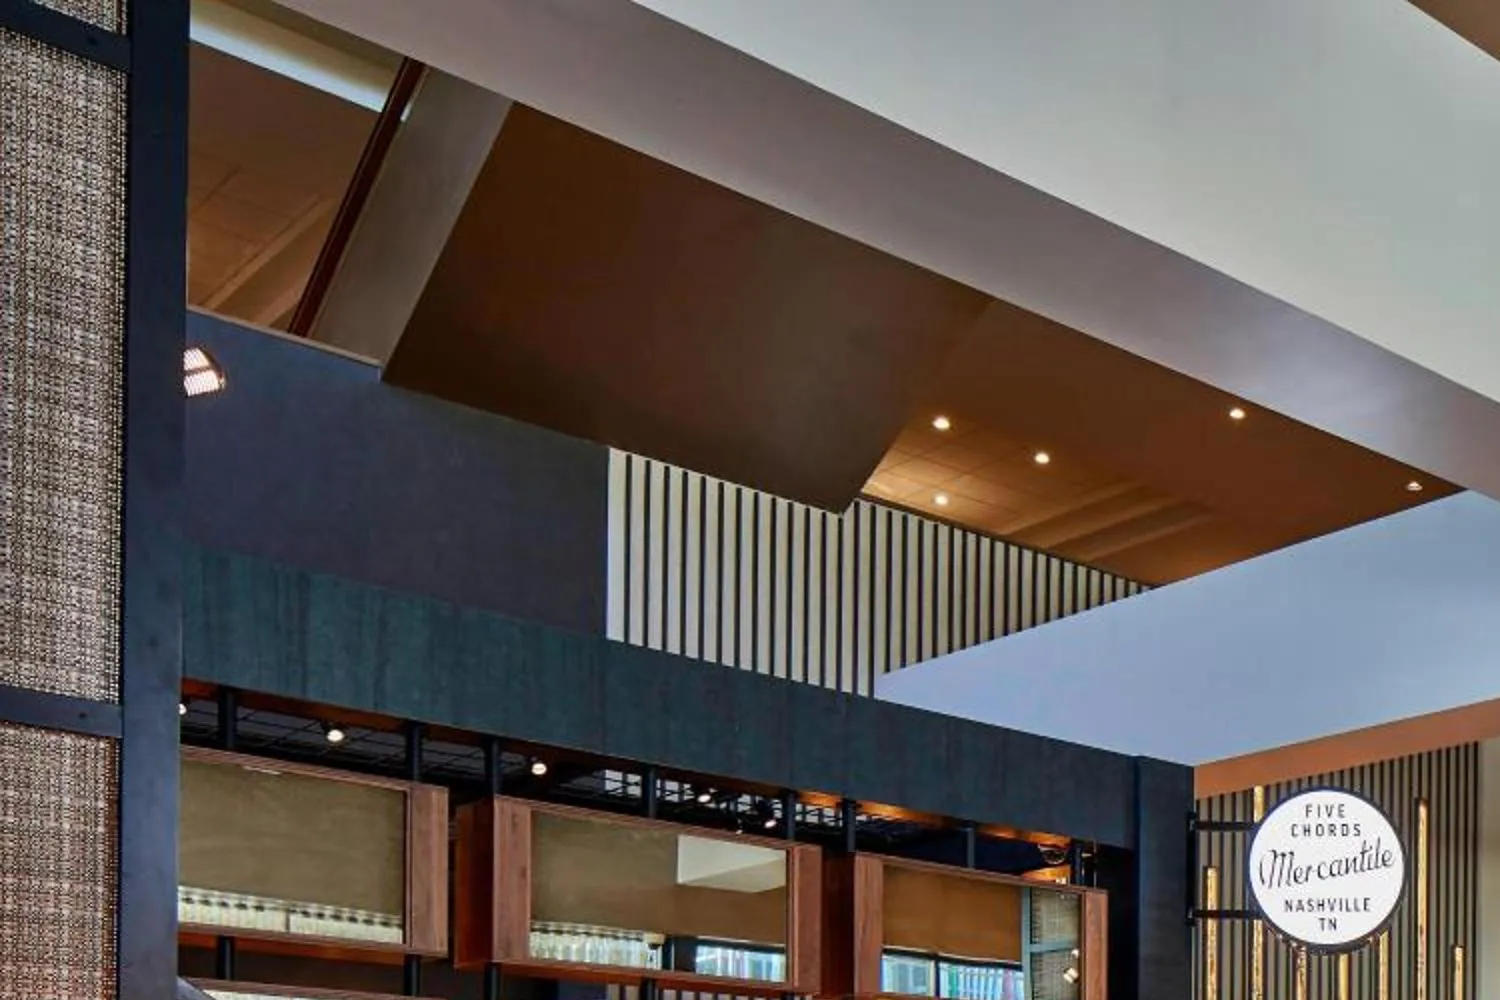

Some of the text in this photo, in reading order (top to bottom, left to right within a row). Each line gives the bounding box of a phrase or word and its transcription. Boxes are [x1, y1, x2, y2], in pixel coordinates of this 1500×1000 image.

[1305, 803, 1345, 819] FIVE
[1291, 823, 1362, 837] CHORDS
[1259, 837, 1394, 889] Mercantile
[1285, 897, 1371, 912] NASHVILLE
[1319, 917, 1338, 931] TN
